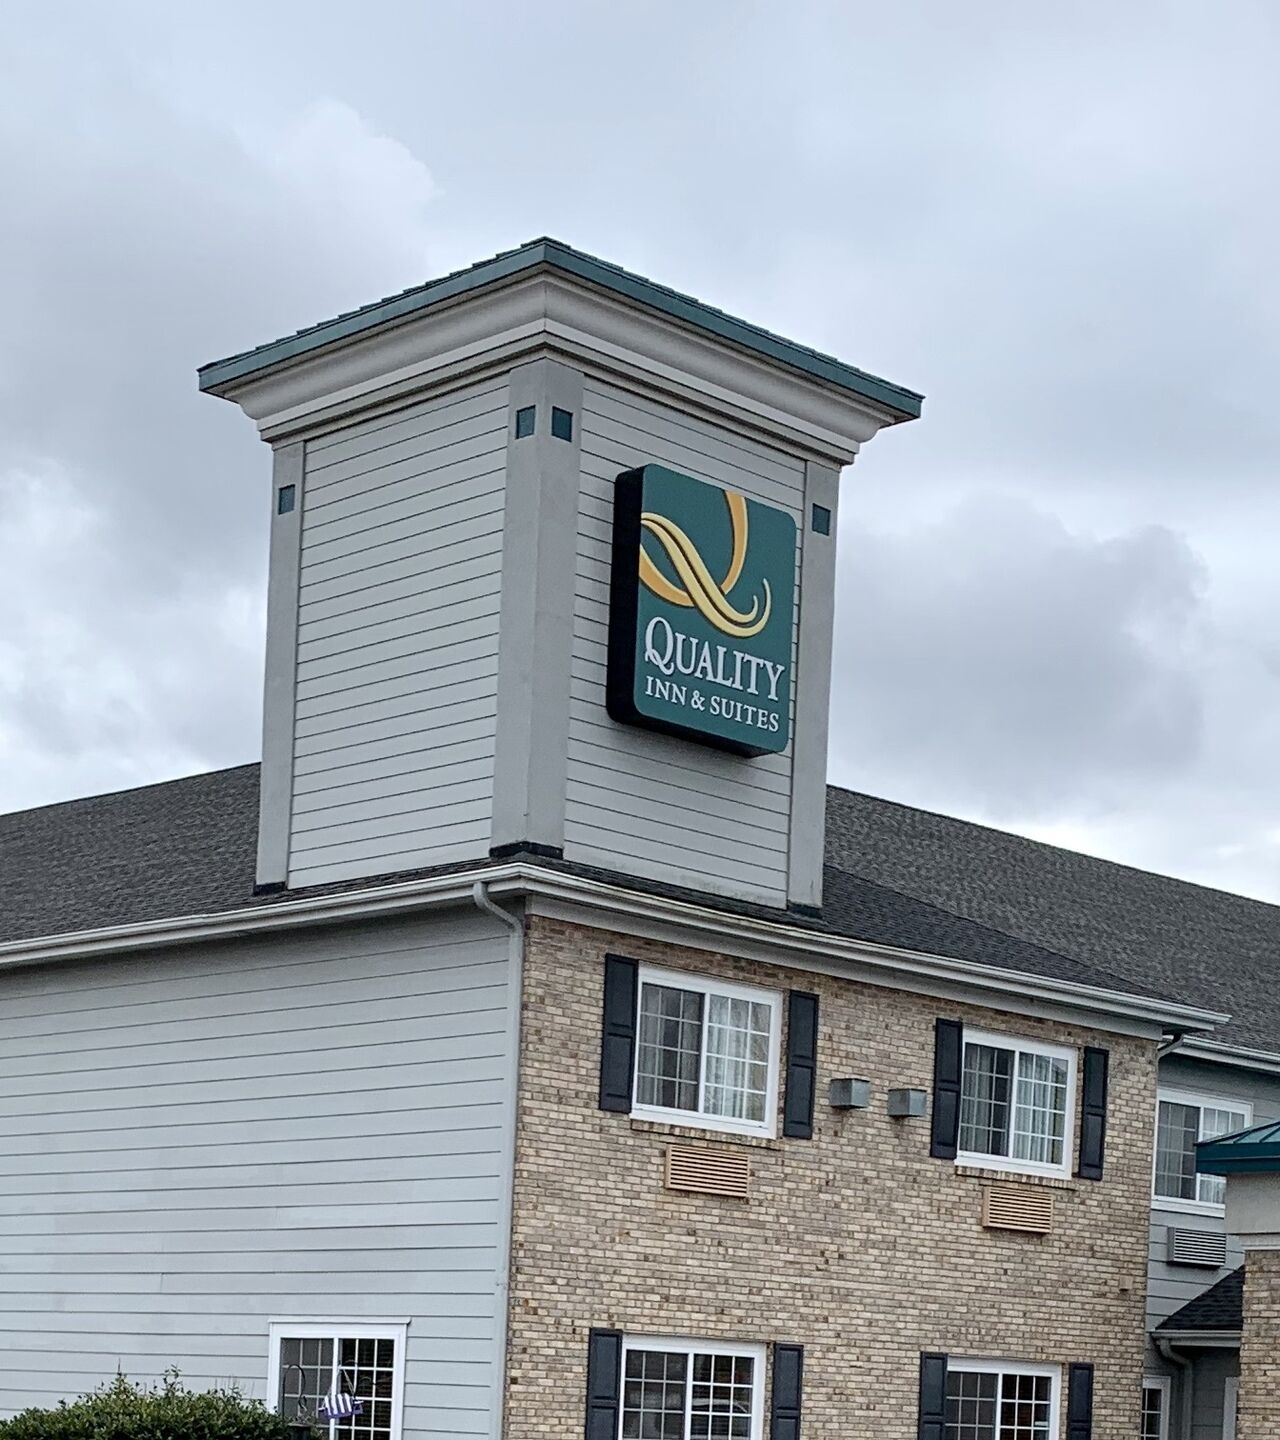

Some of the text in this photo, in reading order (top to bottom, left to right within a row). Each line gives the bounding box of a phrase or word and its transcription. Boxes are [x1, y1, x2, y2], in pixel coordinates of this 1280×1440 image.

[644, 616, 785, 701] QUALITY
[645, 676, 779, 732] INN & SUITES
